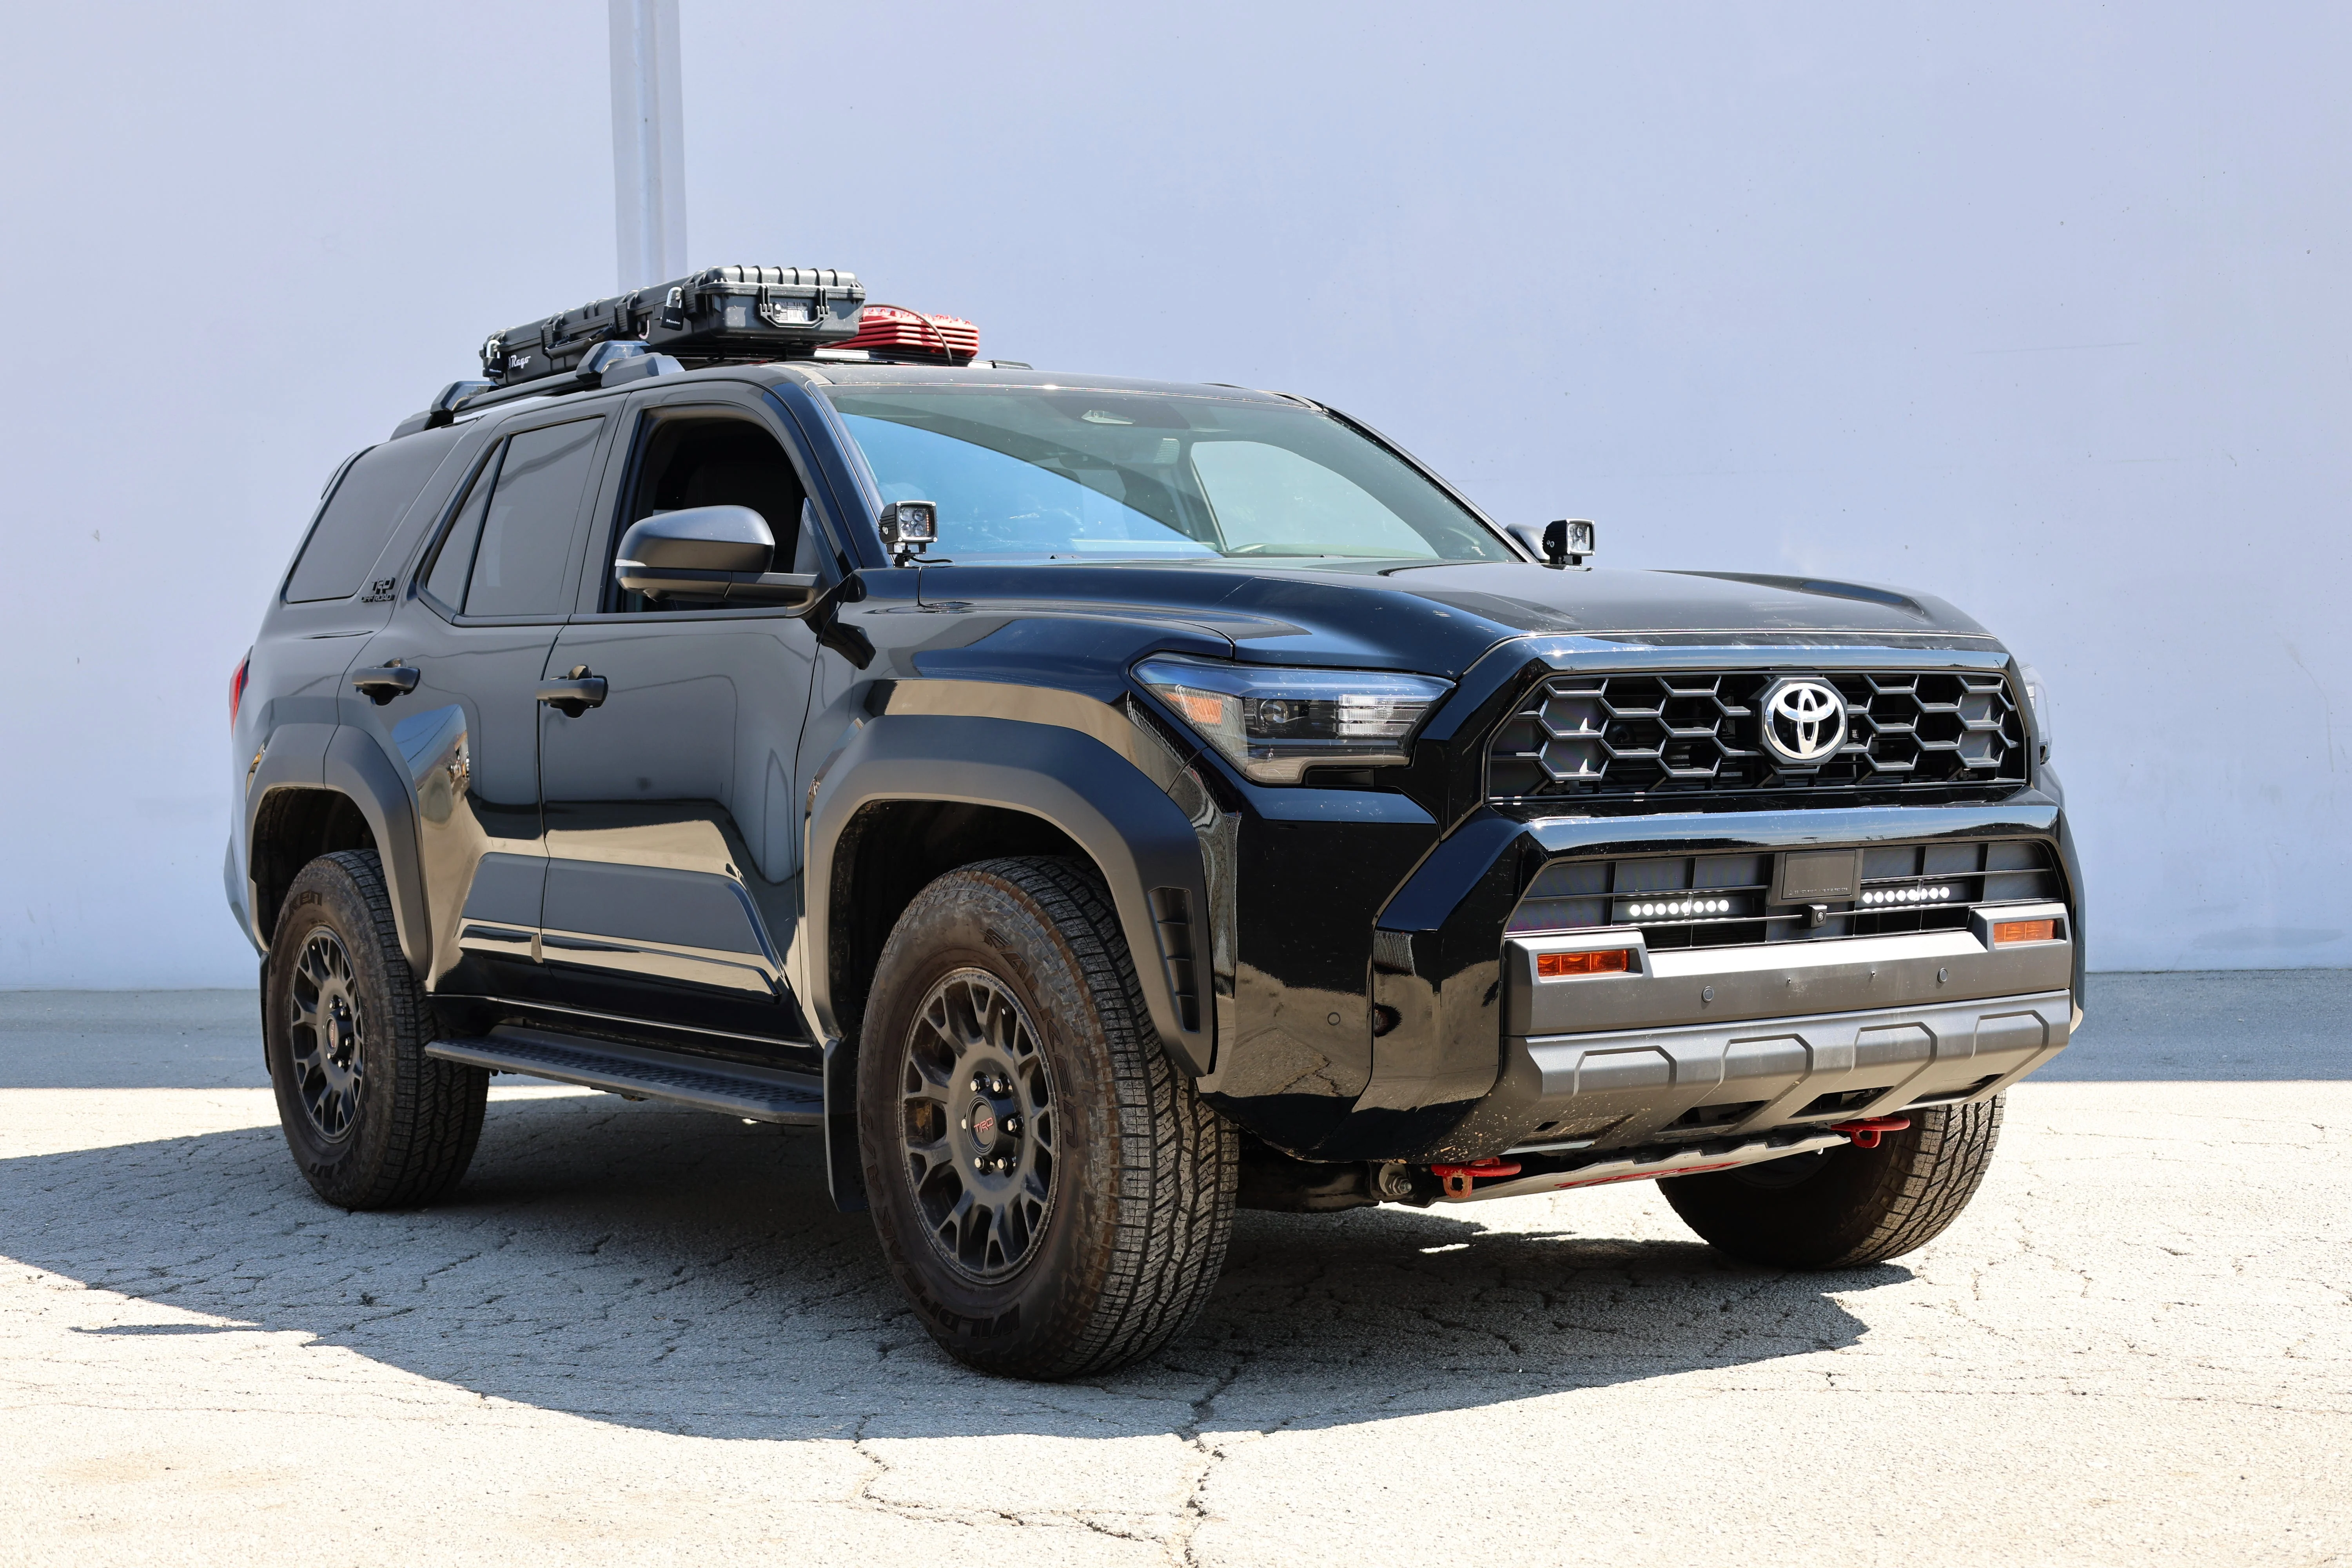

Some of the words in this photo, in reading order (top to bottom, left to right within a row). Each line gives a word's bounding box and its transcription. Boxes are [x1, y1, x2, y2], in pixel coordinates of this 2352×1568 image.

[510, 354, 531, 368] Rago
[372, 577, 396, 594] TRD
[373, 594, 395, 602] ROAD
[974, 1117, 993, 1133] TRD
[875, 1207, 1020, 1339] WILDPEAK
